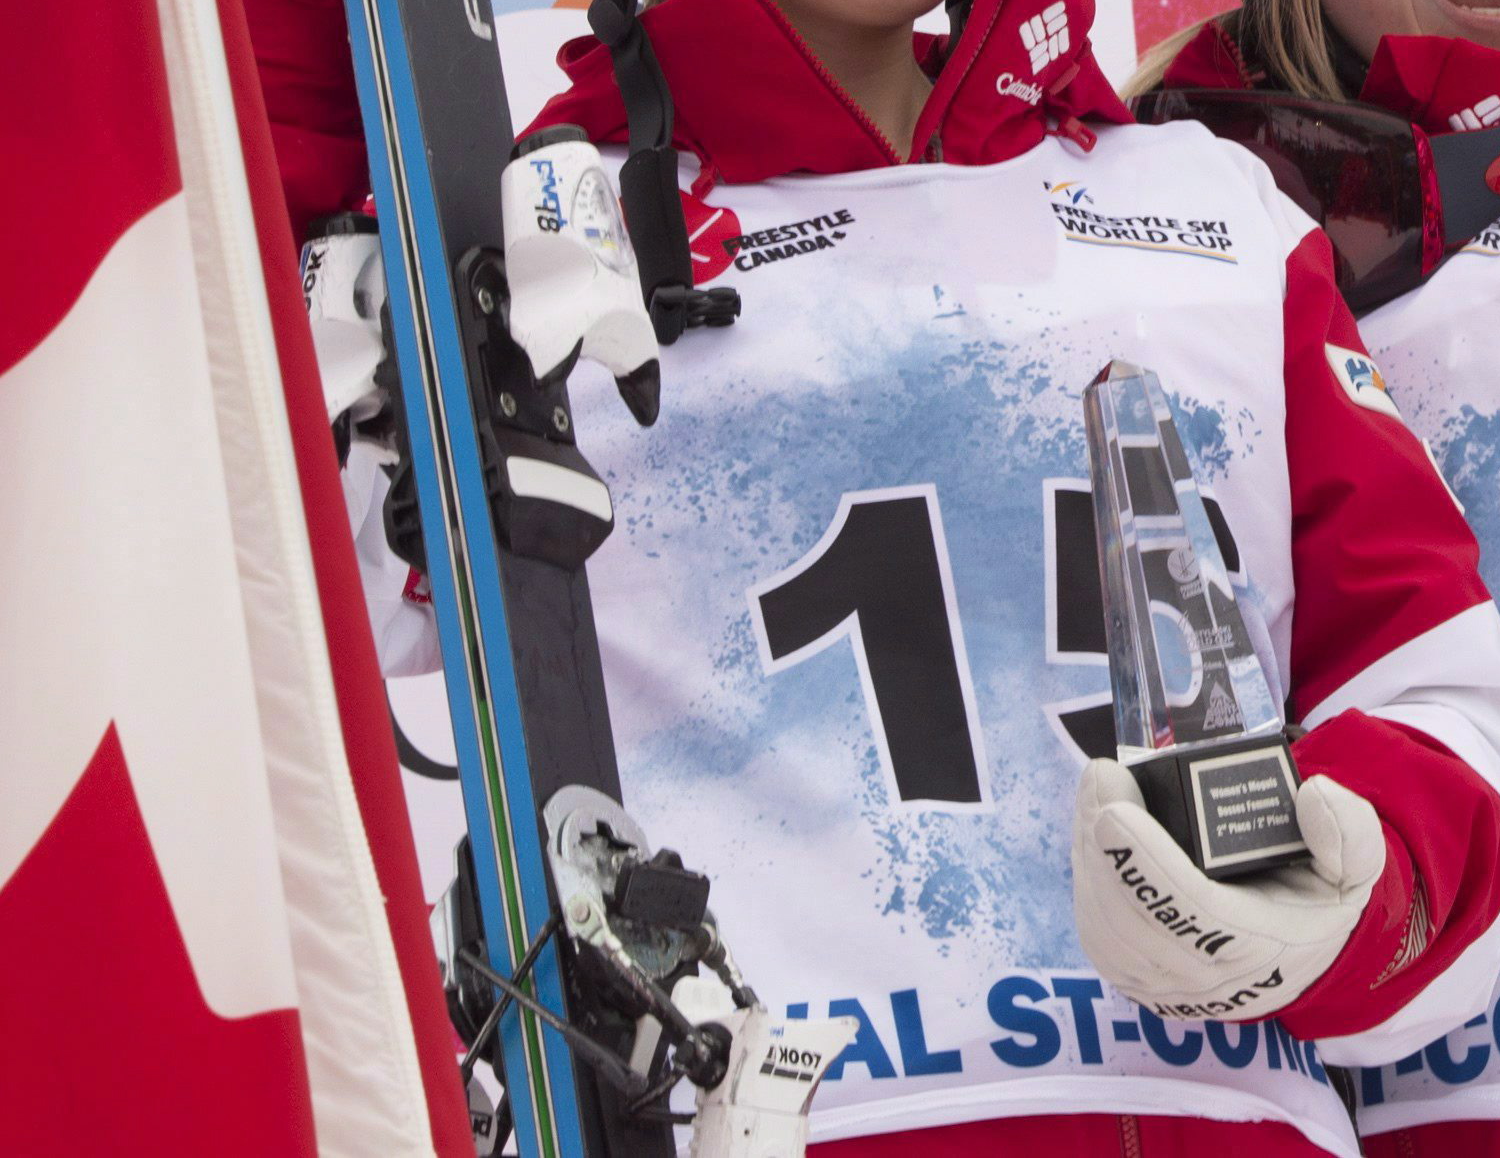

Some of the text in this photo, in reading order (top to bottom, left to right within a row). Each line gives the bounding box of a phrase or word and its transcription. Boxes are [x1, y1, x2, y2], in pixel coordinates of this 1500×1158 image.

[721, 209, 855, 256] FREESTYLE
[1051, 202, 1228, 235] FREESTYLE SKI
[1057, 216, 1232, 251] WORLD CUP
[734, 235, 835, 273] CANADA
[1104, 846, 1201, 939] Auclair
